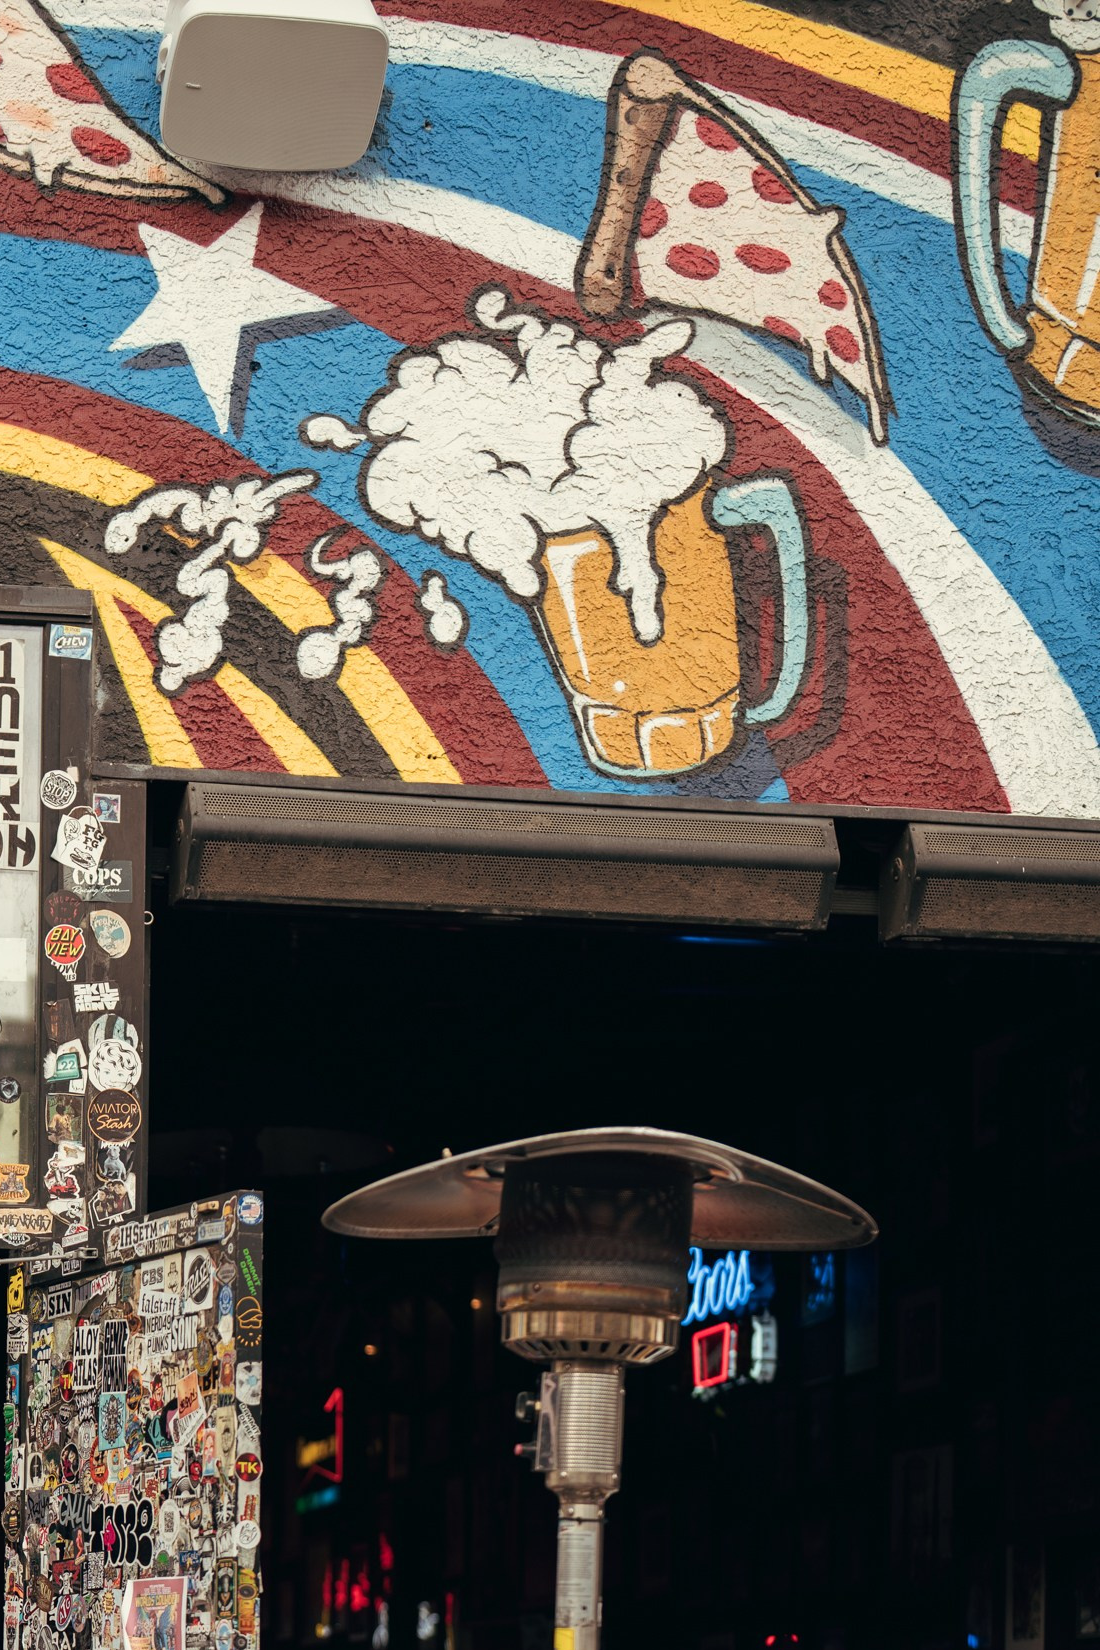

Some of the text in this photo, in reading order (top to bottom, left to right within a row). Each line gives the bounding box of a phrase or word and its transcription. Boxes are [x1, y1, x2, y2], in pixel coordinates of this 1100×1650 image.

[46, 783, 70, 800] STOP
[83, 824, 105, 840] FG
[73, 868, 122, 886] COPS
[51, 929, 78, 942] BAY
[46, 941, 83, 957] VIEW
[91, 1103, 137, 1114] AVIATOR
[96, 1115, 133, 1131] Stash
[243, 1248, 261, 1287] DAMMIT
[142, 1266, 164, 1287] CBS
[48, 1290, 72, 1317] SIN
[141, 1293, 177, 1314] falstaff
[75, 1328, 99, 1357] ALOY
[147, 1335, 169, 1351] PUNKS
[73, 1360, 98, 1387] ATLAS
[237, 1462, 259, 1473] TK
